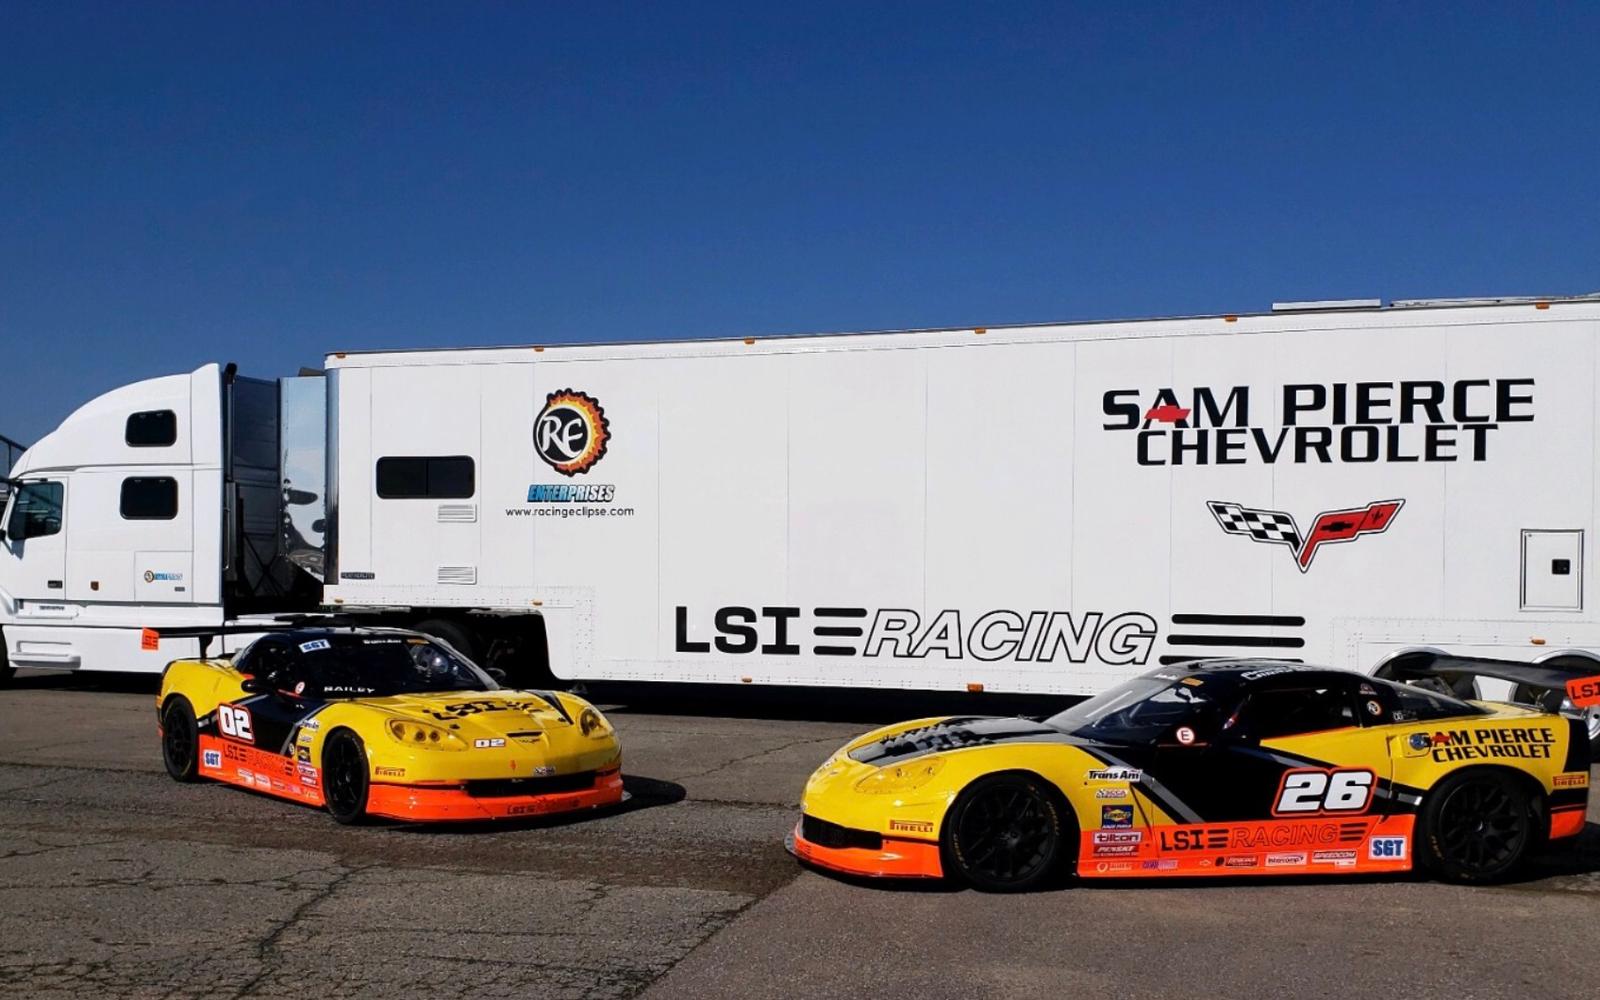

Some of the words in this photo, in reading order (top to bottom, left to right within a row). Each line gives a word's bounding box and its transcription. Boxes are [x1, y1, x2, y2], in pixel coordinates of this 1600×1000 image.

[1102, 386, 1250, 431] SAM
[1282, 377, 1536, 427] PIERCE
[540, 415, 583, 459] RE
[1136, 423, 1499, 466] CHEVROLET
[527, 484, 616, 503] ENTERPRISES
[505, 506, 635, 519] www.racingeclipse.com
[675, 605, 801, 655] LSI
[862, 608, 1158, 666] RACING
[302, 640, 327, 651] SGT
[323, 685, 375, 694] BAILEY
[219, 704, 254, 742] 02
[475, 738, 506, 748] 02
[1475, 728, 1555, 743] PIERCE
[205, 752, 219, 766] SGT
[1432, 744, 1551, 762] CHEVROLET
[375, 766, 406, 778] PIRELLI
[1089, 770, 1118, 780] Trans
[1120, 771, 1139, 780] Am
[1553, 774, 1586, 787] PIRELLI
[1276, 771, 1373, 812] 26
[890, 819, 934, 833] PIRELLI
[1096, 835, 1139, 843] tilton
[1161, 830, 1204, 850] LSI
[1231, 824, 1338, 849] RACING
[1372, 840, 1403, 856] SGT
